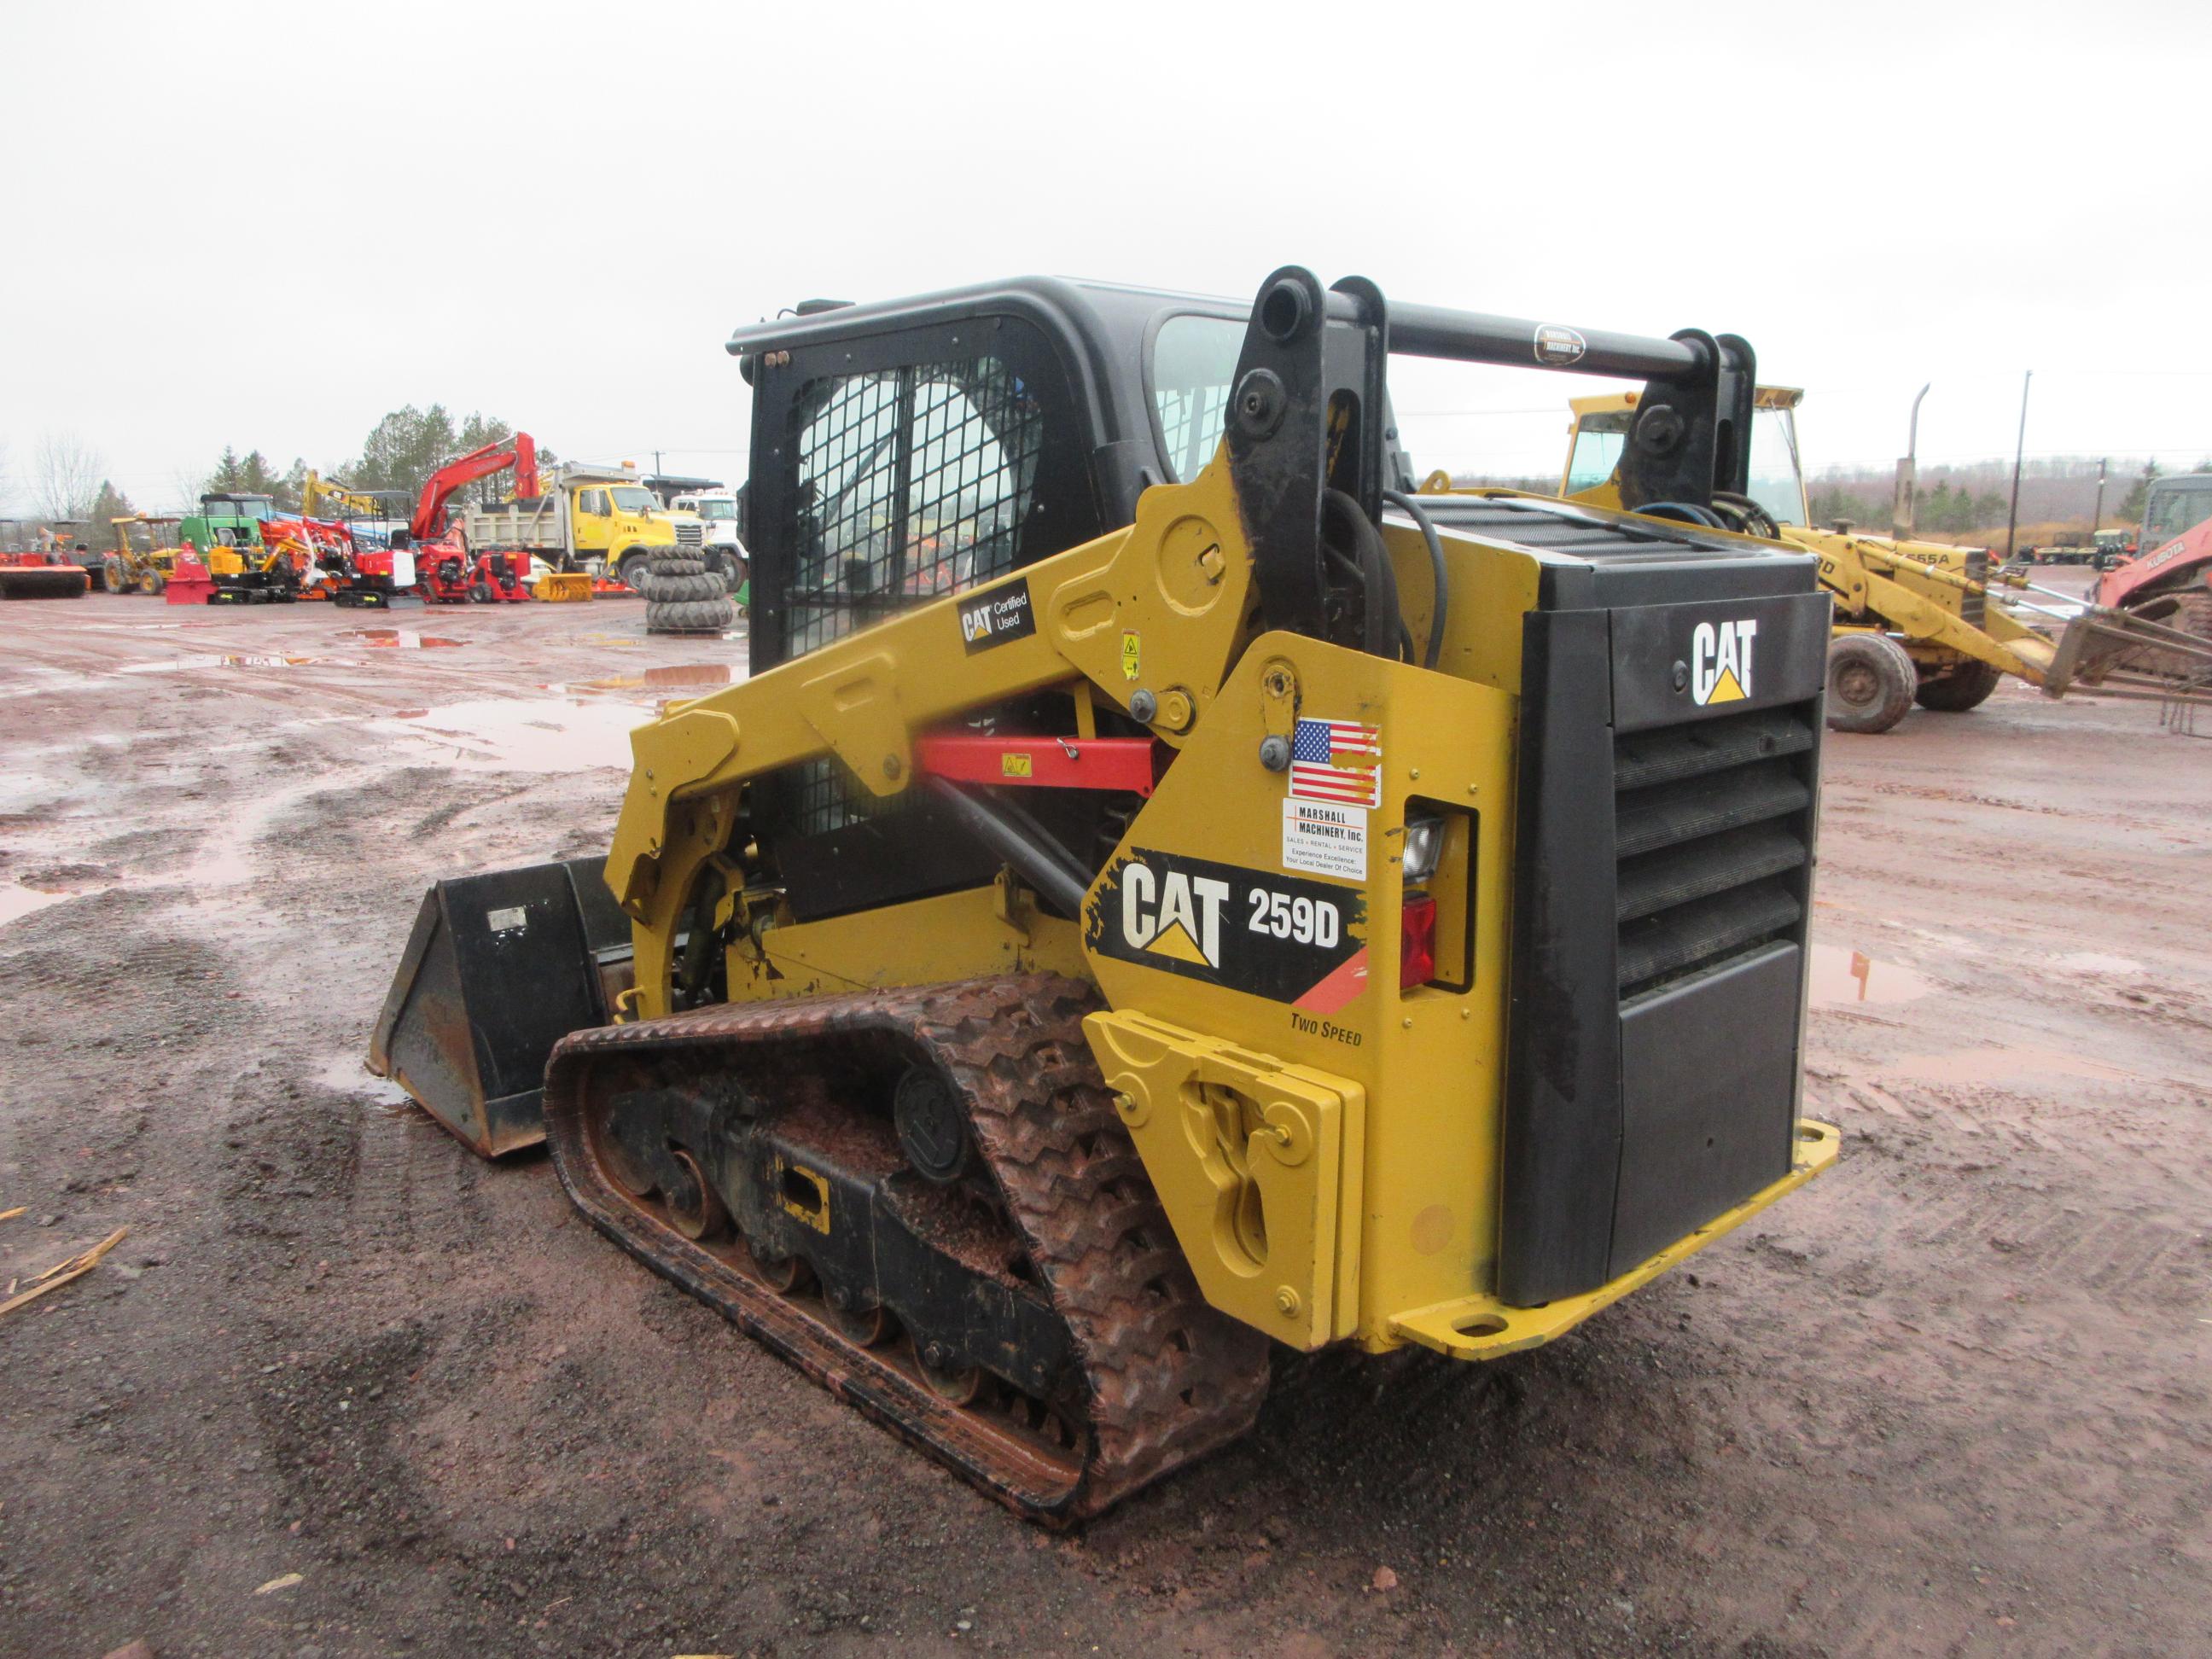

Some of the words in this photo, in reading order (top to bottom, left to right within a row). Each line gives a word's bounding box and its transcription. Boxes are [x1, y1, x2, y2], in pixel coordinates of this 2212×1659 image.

[2146, 541, 2186, 569] KUBOTA
[993, 591, 1027, 614] Certified
[962, 605, 992, 643] CAT
[997, 612, 1020, 631] Used
[1692, 619, 1757, 707] CAT
[1299, 806, 1346, 824] MARSHALL
[1299, 822, 1346, 841] MACHINERY,
[1348, 829, 1364, 842] Inc.
[1286, 836, 1304, 845] SALES
[1310, 840, 1332, 849] RENTAL
[1338, 844, 1363, 854] SERVICE
[1291, 848, 1323, 859] Experience
[1315, 860, 1334, 870] Dealer
[1342, 865, 1363, 875] Choice
[1122, 862, 1229, 969] CAT
[1248, 888, 1340, 949] 259D
